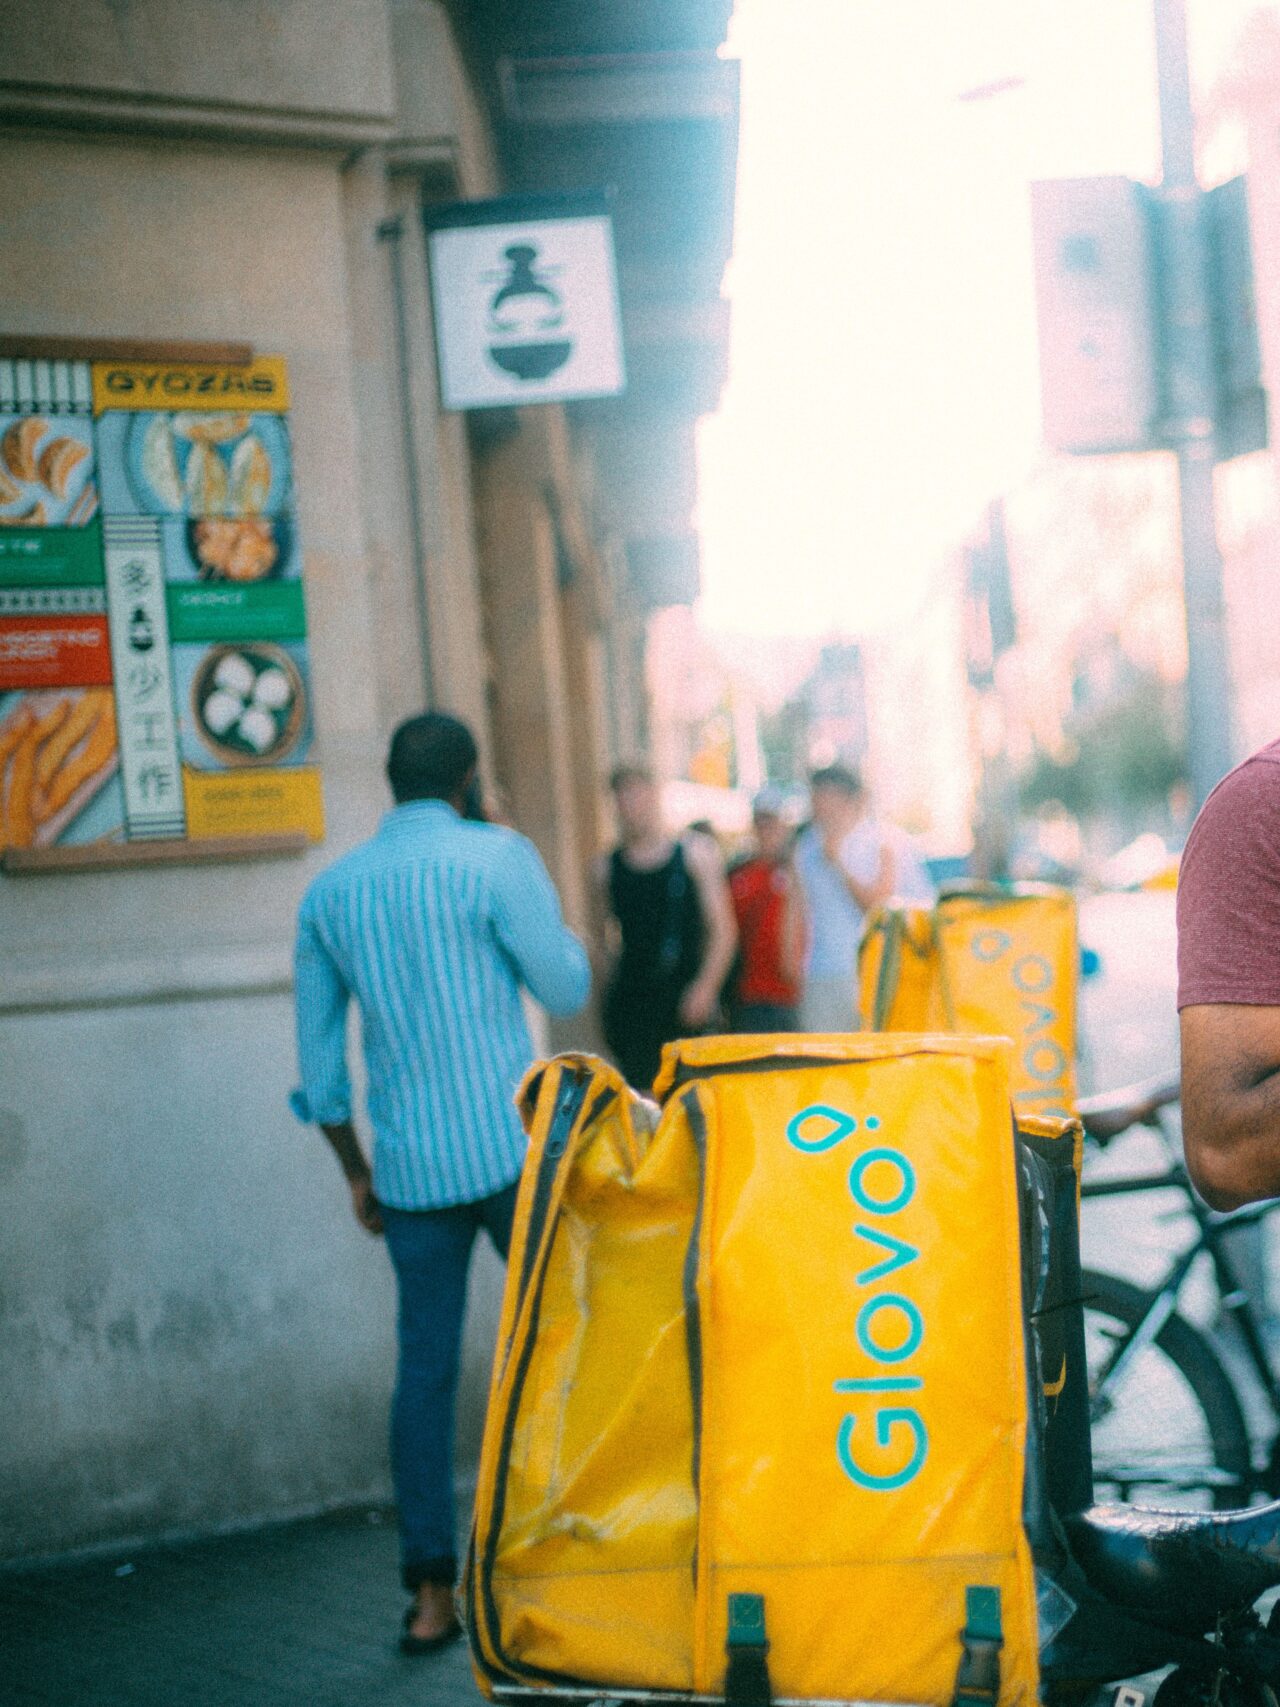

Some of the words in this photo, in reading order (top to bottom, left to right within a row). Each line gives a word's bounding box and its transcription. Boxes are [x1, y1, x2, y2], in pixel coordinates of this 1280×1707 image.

[105, 370, 275, 395] GYOZAS
[1010, 953, 1070, 1119] lovo
[833, 1146, 929, 1491] Glovo
